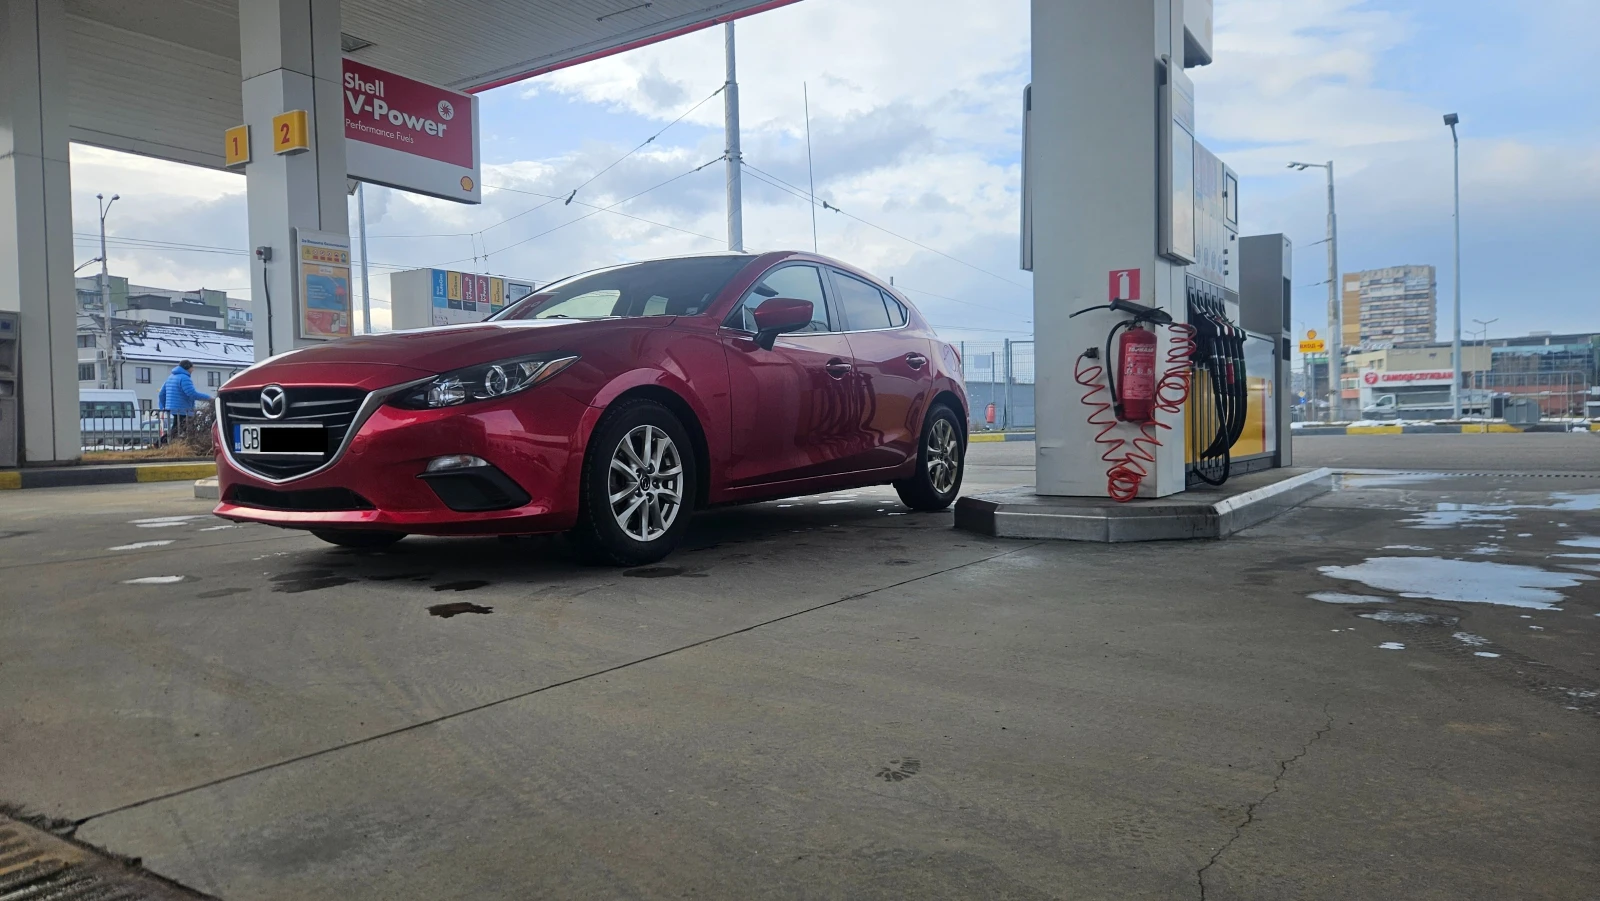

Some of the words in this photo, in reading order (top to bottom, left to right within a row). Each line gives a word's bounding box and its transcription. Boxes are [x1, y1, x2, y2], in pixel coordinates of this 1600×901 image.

[344, 72, 385, 98] Shell
[345, 90, 447, 138] V-Power
[280, 123, 290, 145] 2
[345, 118, 395, 139] Performance
[396, 131, 415, 144] Fuels
[232, 136, 239, 157] 1
[1381, 372, 1454, 382] САМООБСЛУЖВАН
